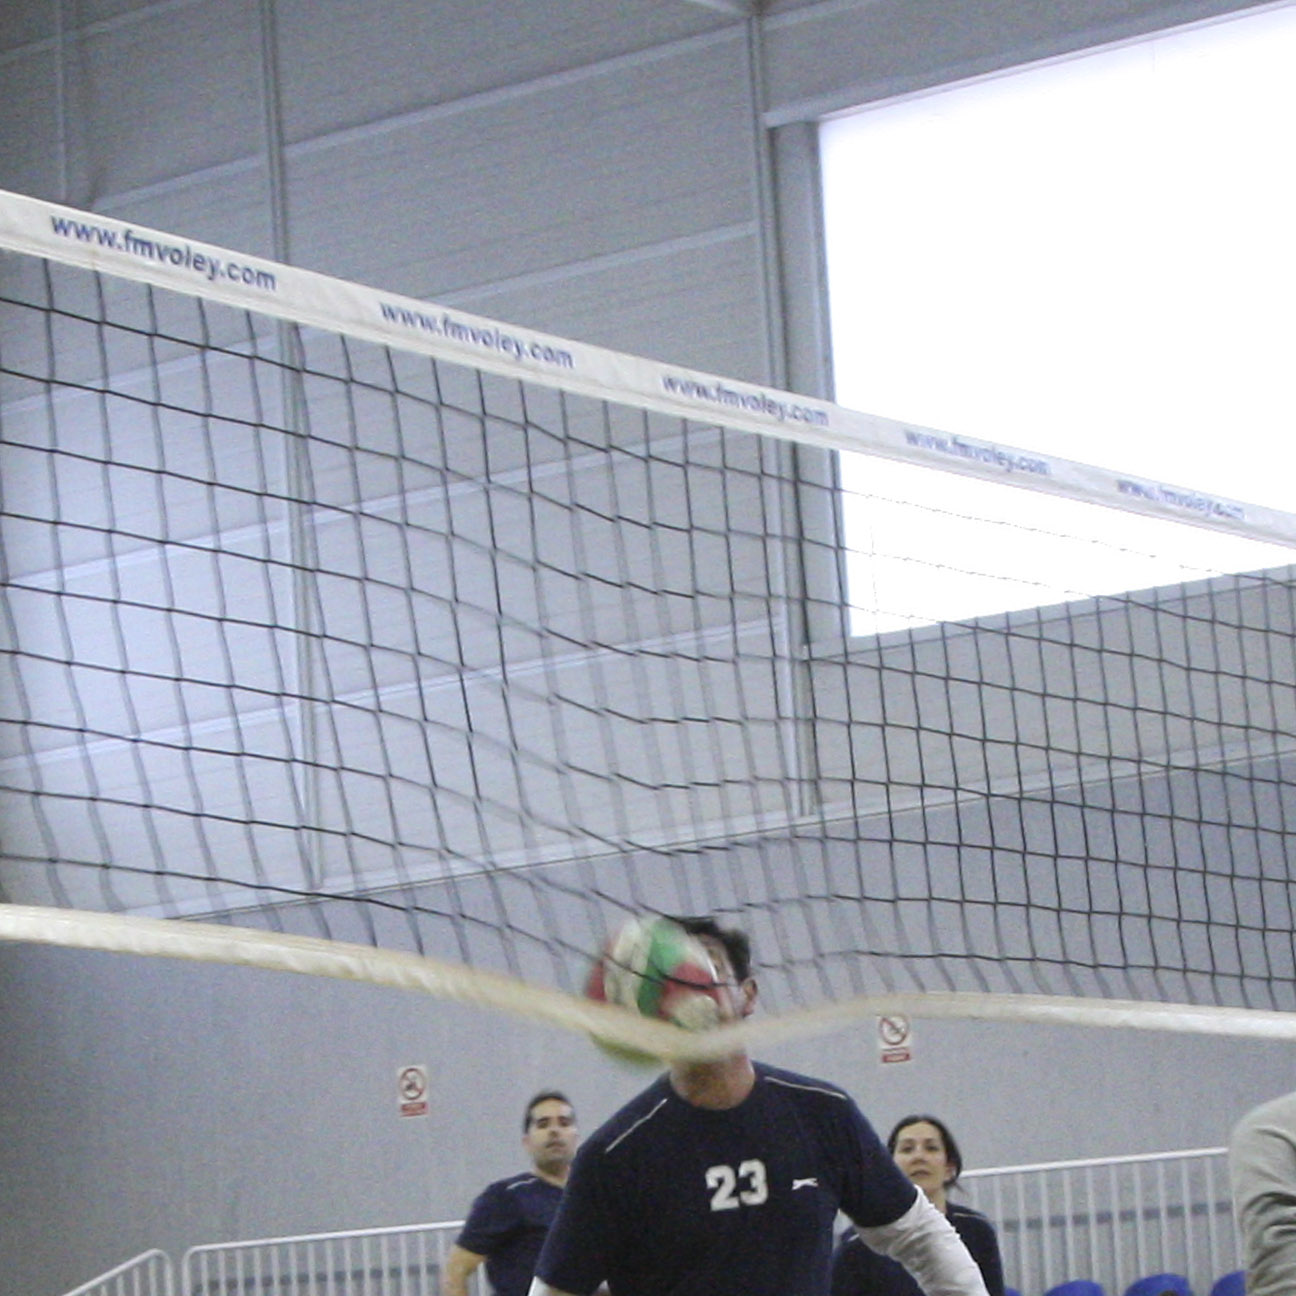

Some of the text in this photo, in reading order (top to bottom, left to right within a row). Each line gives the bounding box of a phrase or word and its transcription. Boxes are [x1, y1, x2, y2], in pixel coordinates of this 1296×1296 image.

[51, 216, 277, 291] www.fmvoley.com
[380, 303, 575, 368] www.fmvoley.com
[705, 1158, 769, 1211] 23
